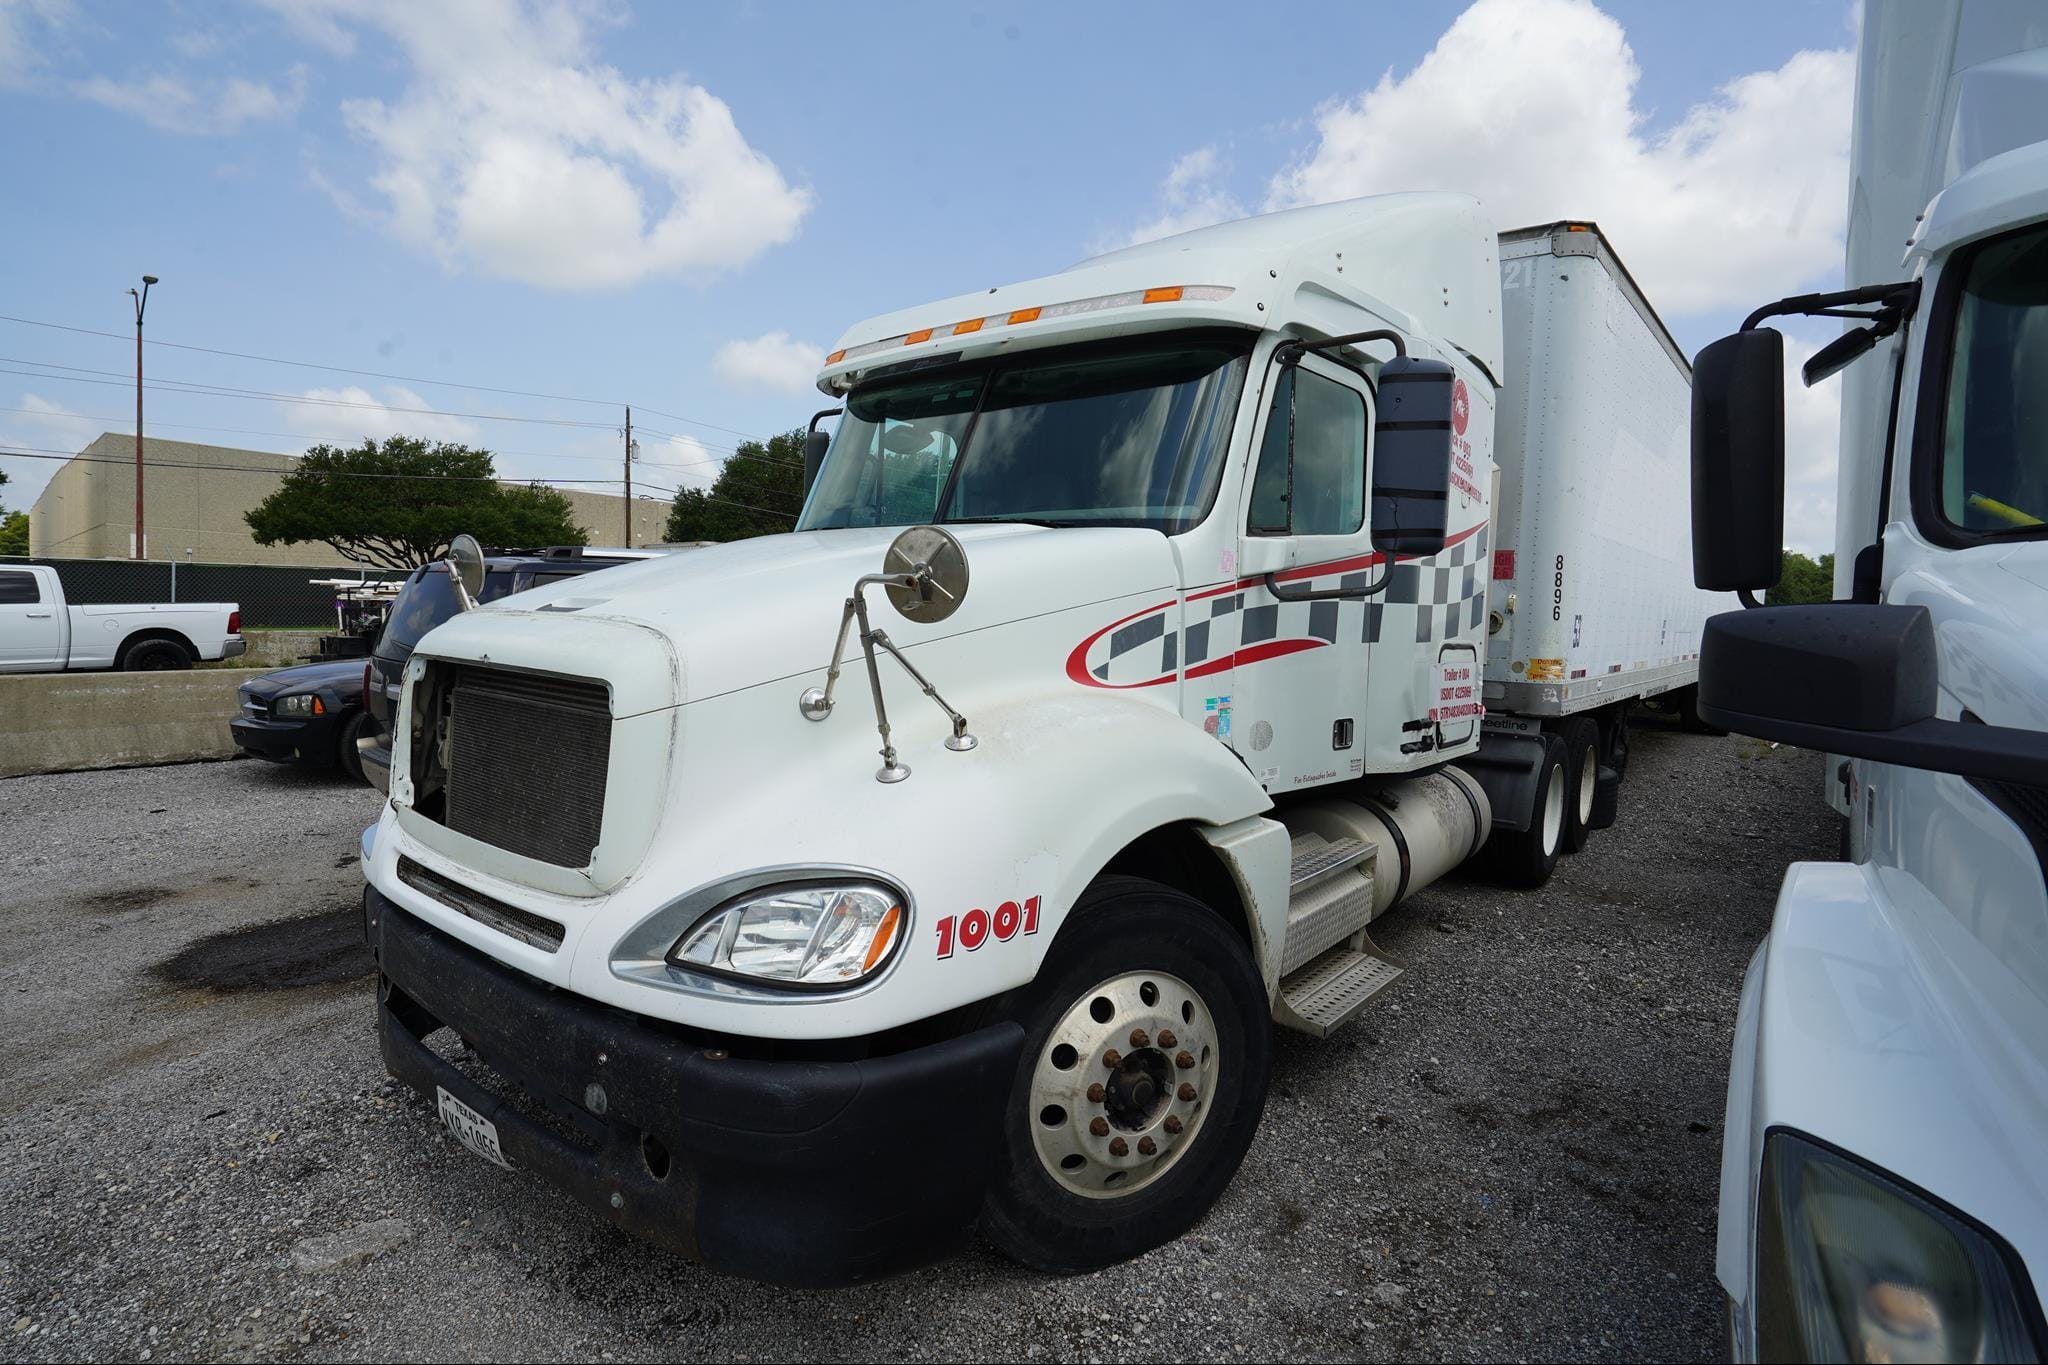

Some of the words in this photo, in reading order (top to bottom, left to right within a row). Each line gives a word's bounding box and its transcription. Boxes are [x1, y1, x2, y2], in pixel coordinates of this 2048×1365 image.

[1552, 555, 1564, 621] 8896
[936, 895, 1042, 960] 1001
[454, 1101, 478, 1125] TEXAS
